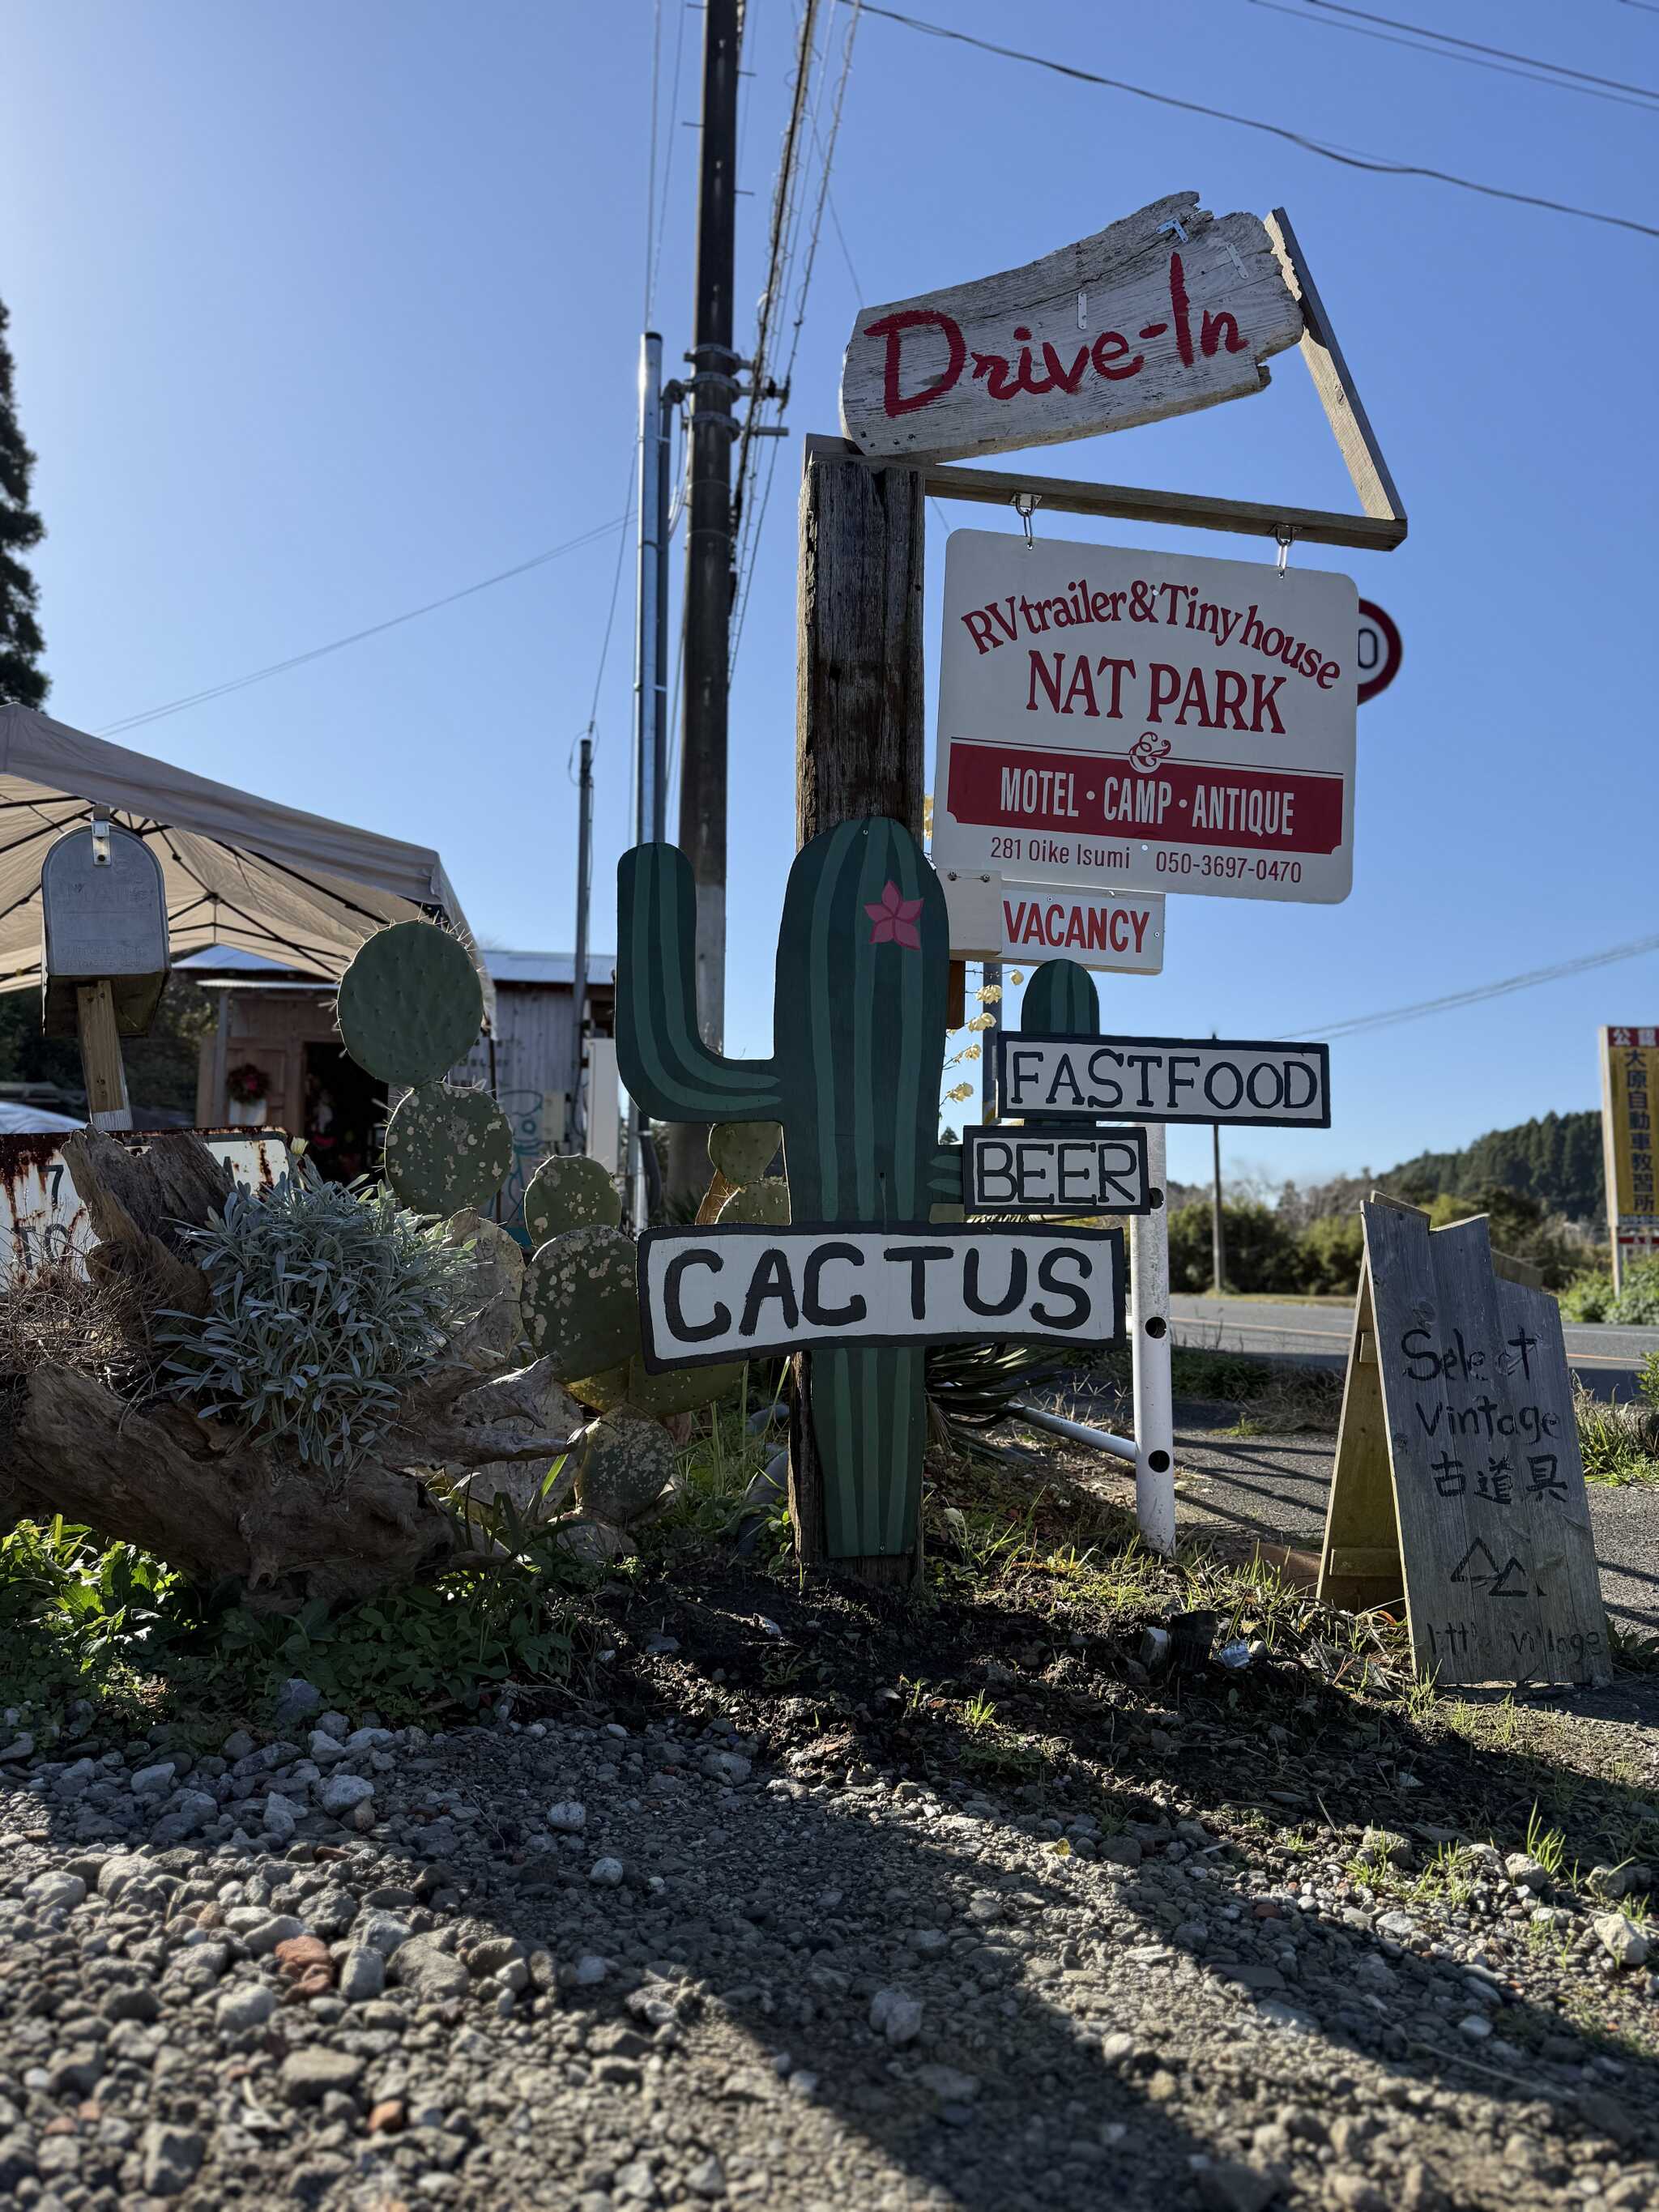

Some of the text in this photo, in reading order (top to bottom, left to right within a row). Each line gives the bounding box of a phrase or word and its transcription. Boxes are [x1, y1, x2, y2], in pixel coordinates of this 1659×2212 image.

[864, 253, 1248, 418] Drive-In
[1026, 650, 1287, 735] NAT PARK
[1000, 766, 1295, 837] MOTEL CAMP ANTIQUE
[990, 837, 1303, 884] 281 Oike Isumi 050-3697-0470
[1003, 900, 1150, 953] VACANCY
[1011, 1048, 1318, 1110] FASTFOOD
[977, 1141, 1137, 1204] BEER
[664, 1242, 1093, 1342] CACTUS
[1401, 1324, 1537, 1382] Select
[1414, 1395, 1562, 1445] Vintage
[1431, 1450, 1569, 1504] 古道具
